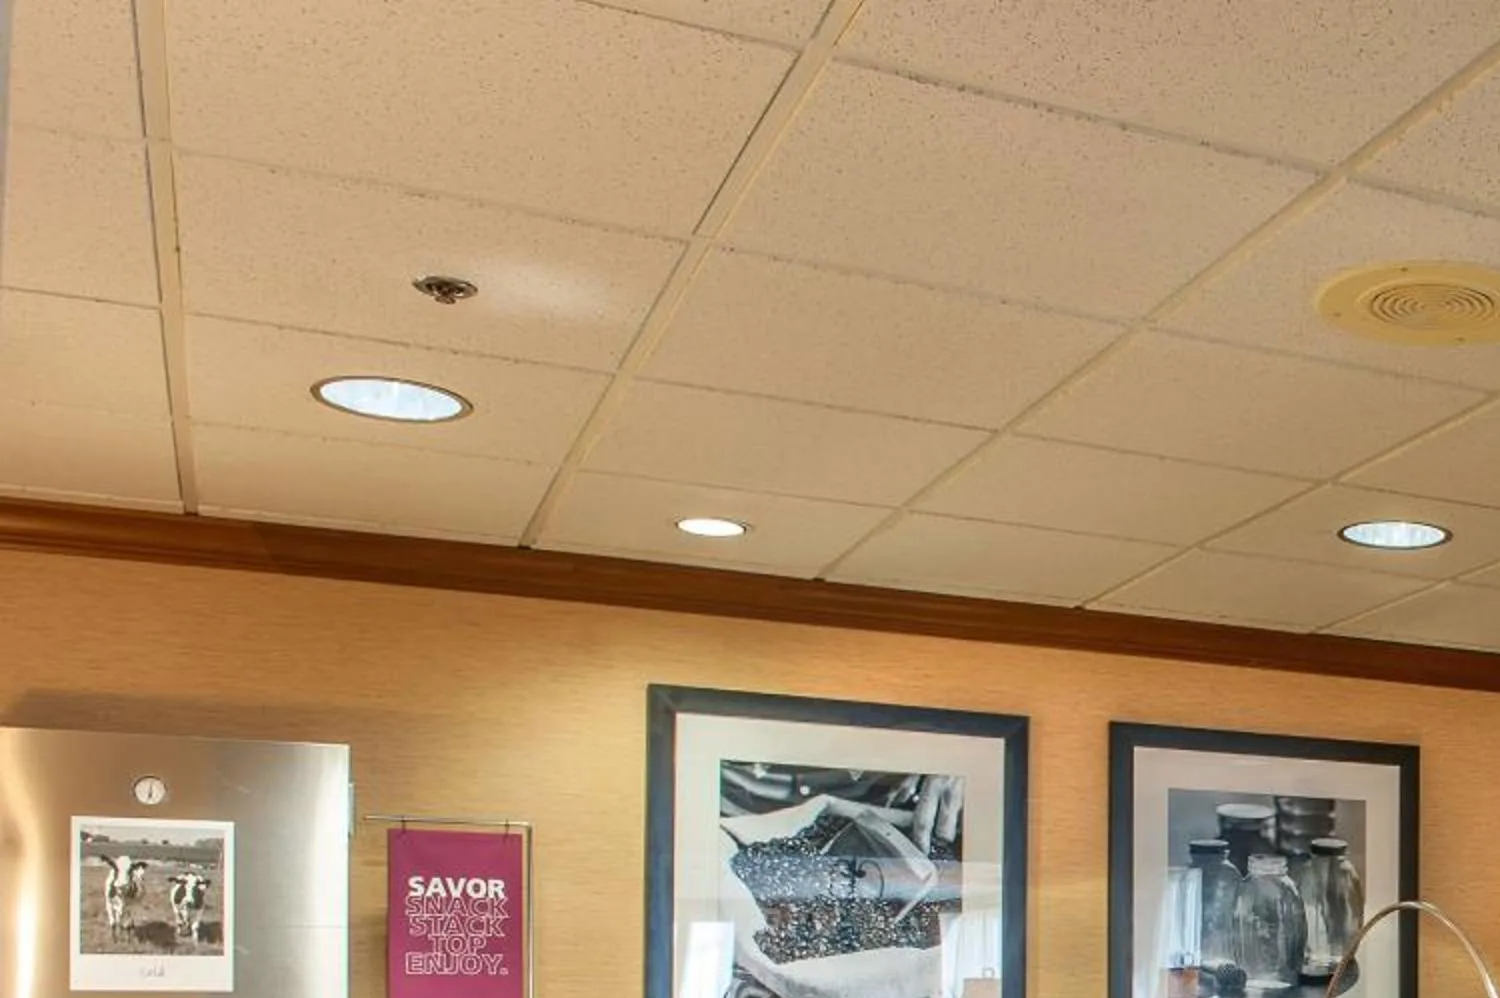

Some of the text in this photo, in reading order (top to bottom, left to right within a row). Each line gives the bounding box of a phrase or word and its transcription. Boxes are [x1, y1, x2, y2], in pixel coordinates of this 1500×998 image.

[407, 876, 505, 898] SAVOR
[405, 896, 510, 918] SNACK
[409, 915, 505, 937] STACK
[427, 933, 487, 956] TOP
[405, 952, 509, 975] ENJOY.
